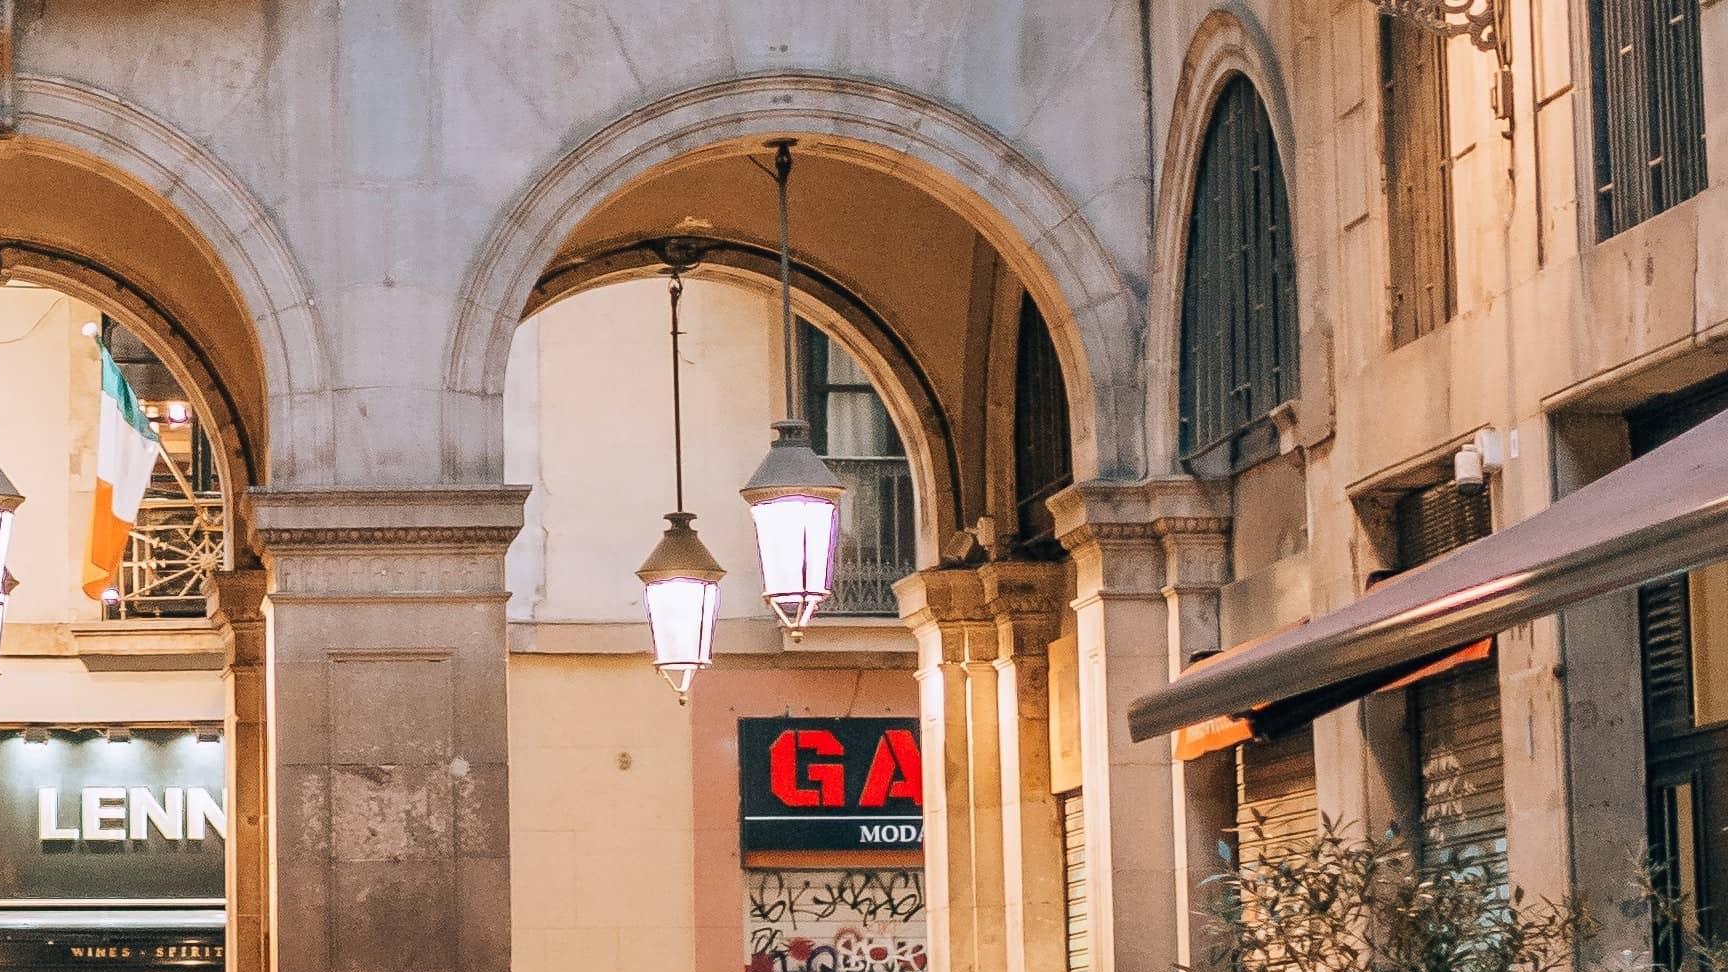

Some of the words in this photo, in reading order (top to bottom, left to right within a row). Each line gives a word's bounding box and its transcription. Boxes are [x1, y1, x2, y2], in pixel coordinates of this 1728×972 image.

[769, 730, 923, 808] GA
[38, 786, 227, 841] LENN
[860, 825, 924, 843] MOD
[70, 946, 131, 958] WINES
